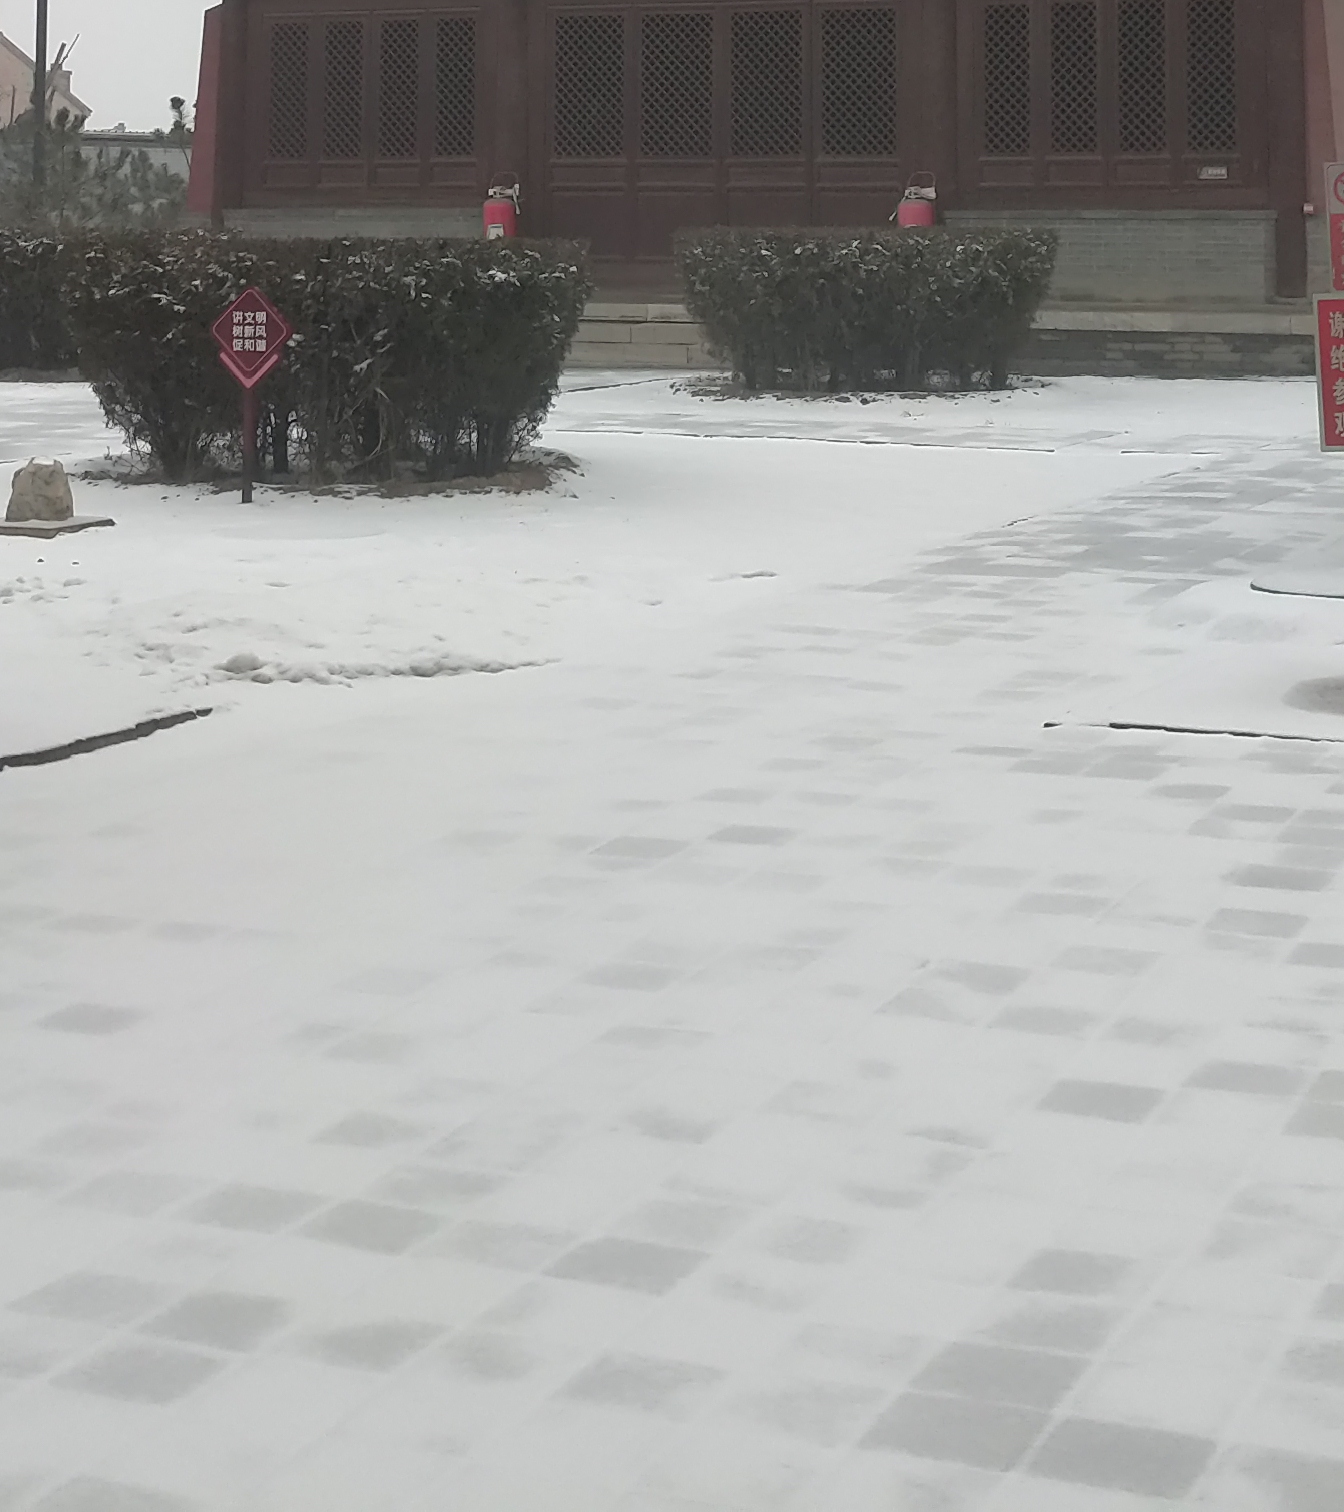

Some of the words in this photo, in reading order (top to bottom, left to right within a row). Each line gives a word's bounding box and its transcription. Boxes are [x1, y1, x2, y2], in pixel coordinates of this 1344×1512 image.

[232, 311, 267, 324] 讲文明
[232, 325, 267, 338] 树新风
[232, 339, 267, 352] 促和谐
